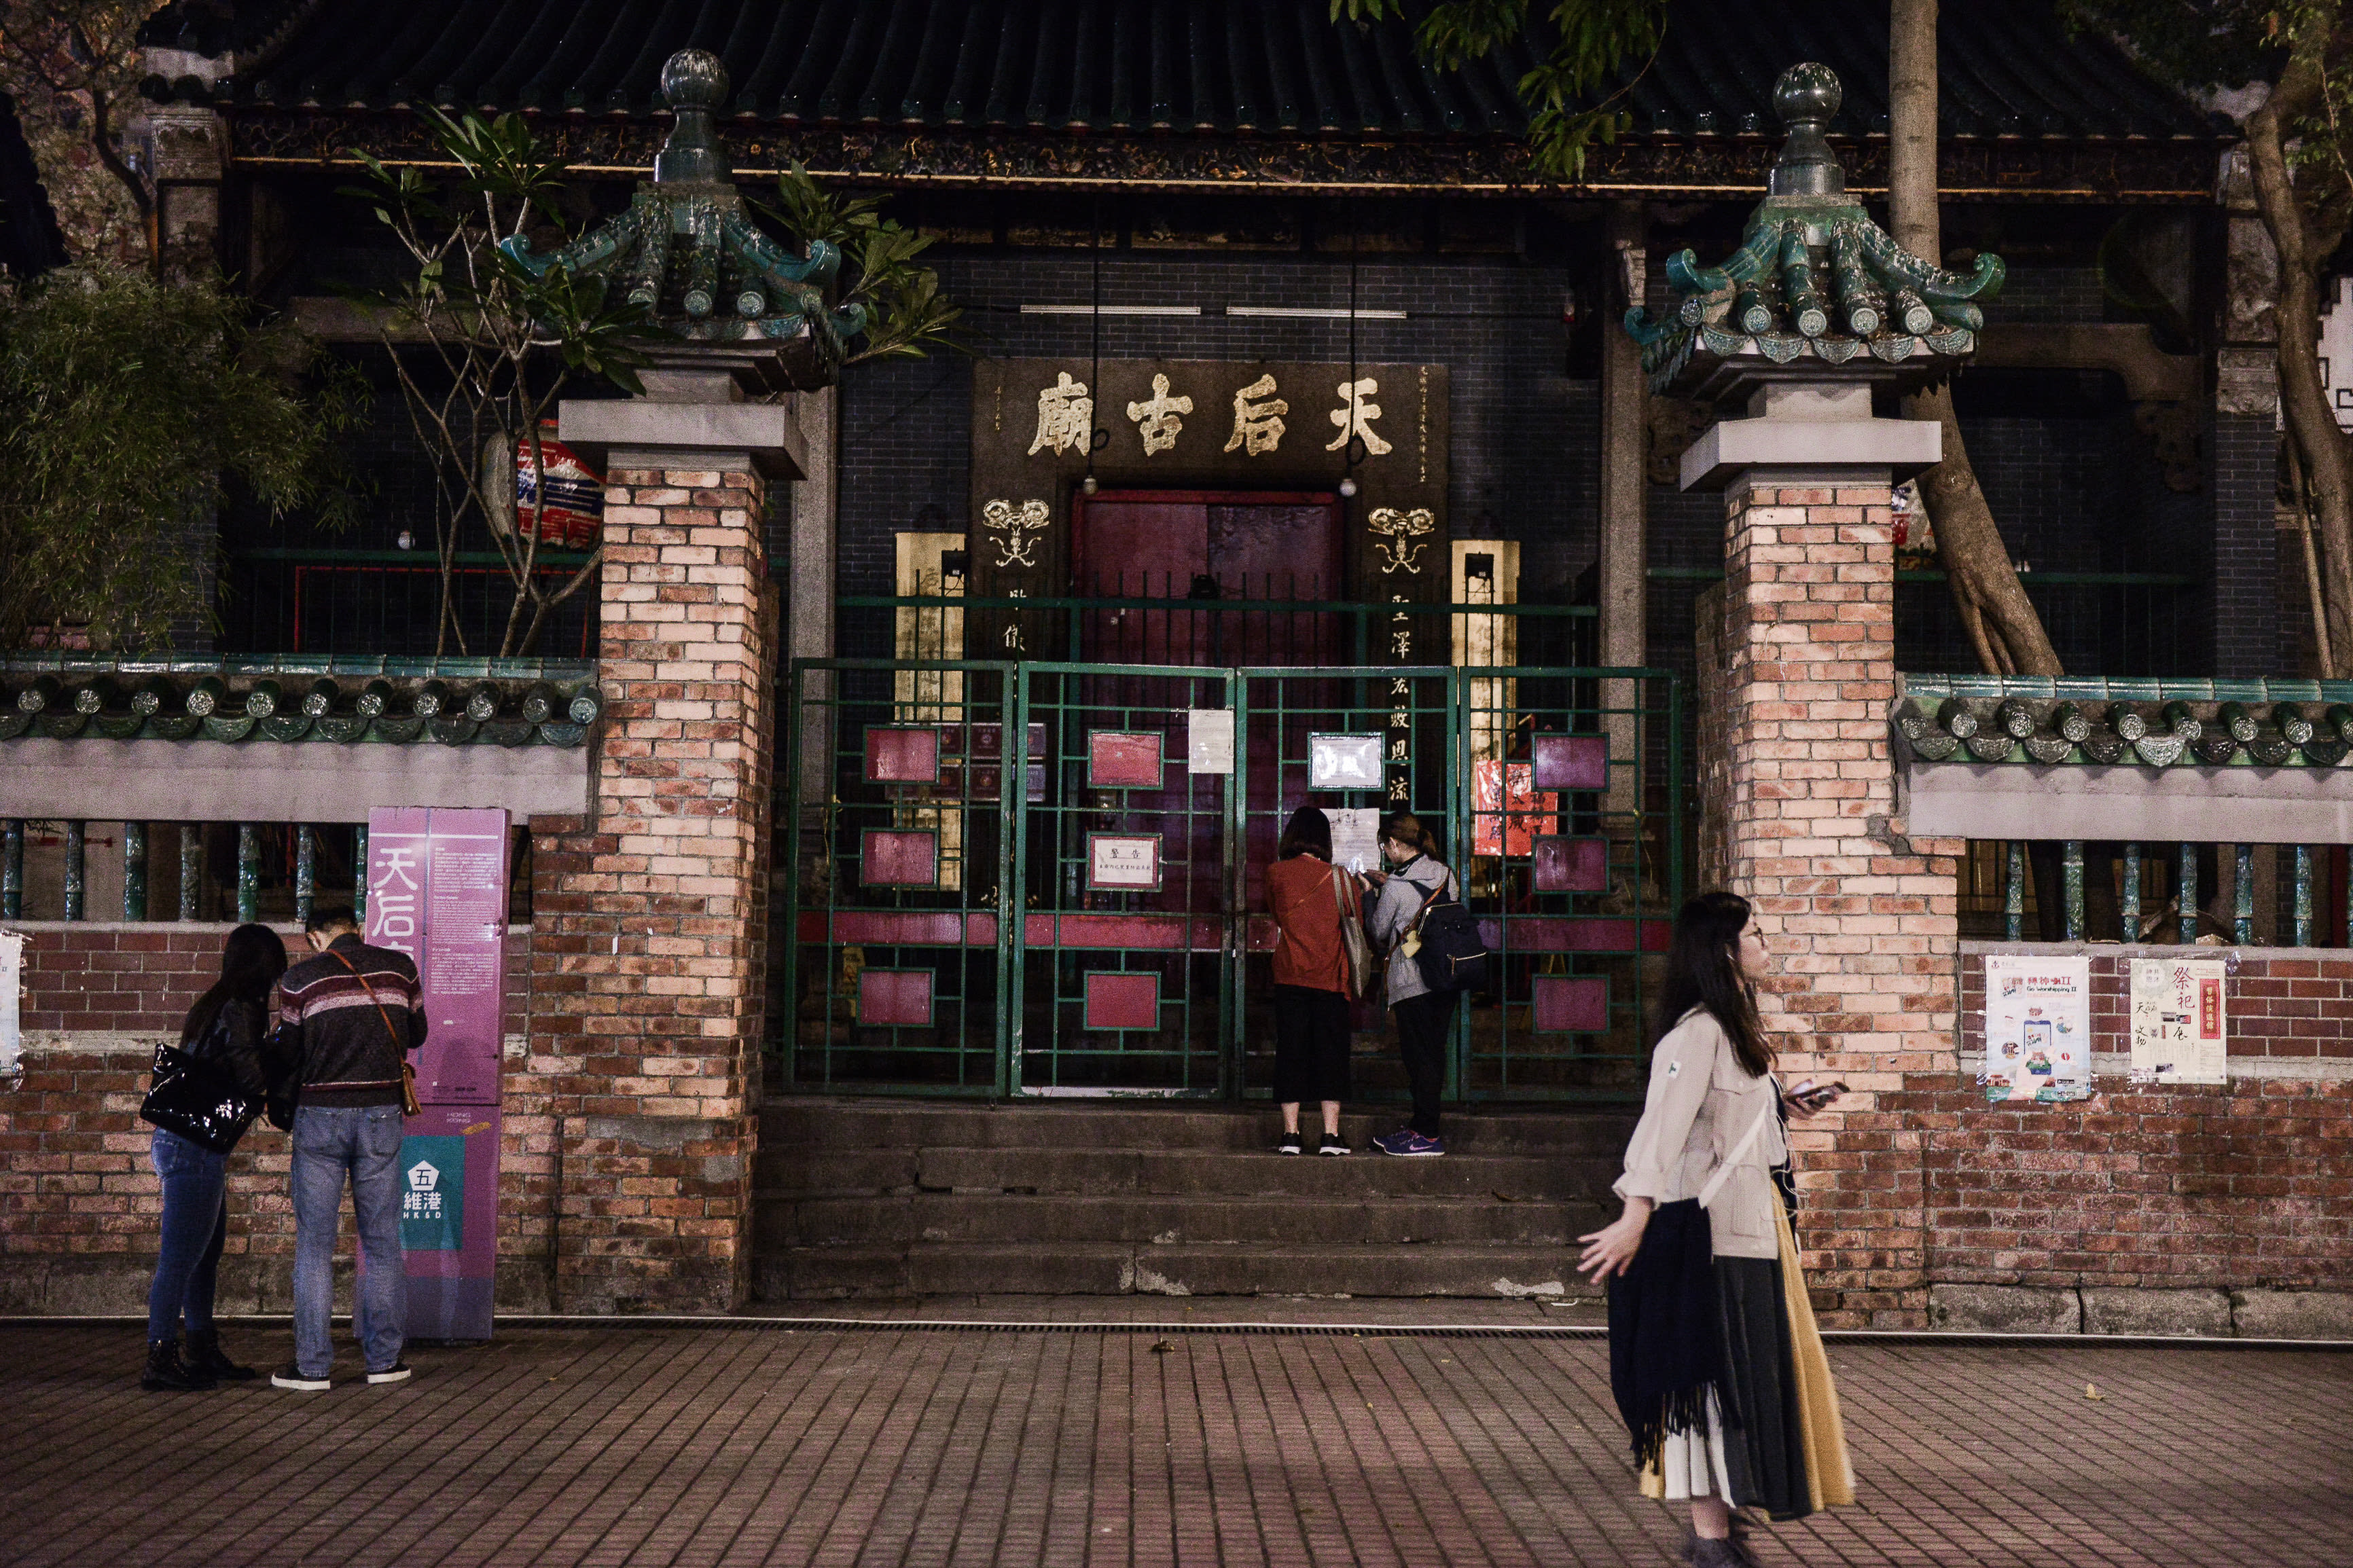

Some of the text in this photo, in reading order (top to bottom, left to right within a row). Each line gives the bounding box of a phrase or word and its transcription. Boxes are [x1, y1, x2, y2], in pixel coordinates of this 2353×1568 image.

[1028, 371, 1393, 457] 天后古廟
[1111, 848, 1141, 858] 警告
[372, 847, 418, 960] 天后
[2172, 966, 2195, 1009] 祭祀
[414, 1169, 431, 1186] 五
[403, 1192, 442, 1210] 維港
